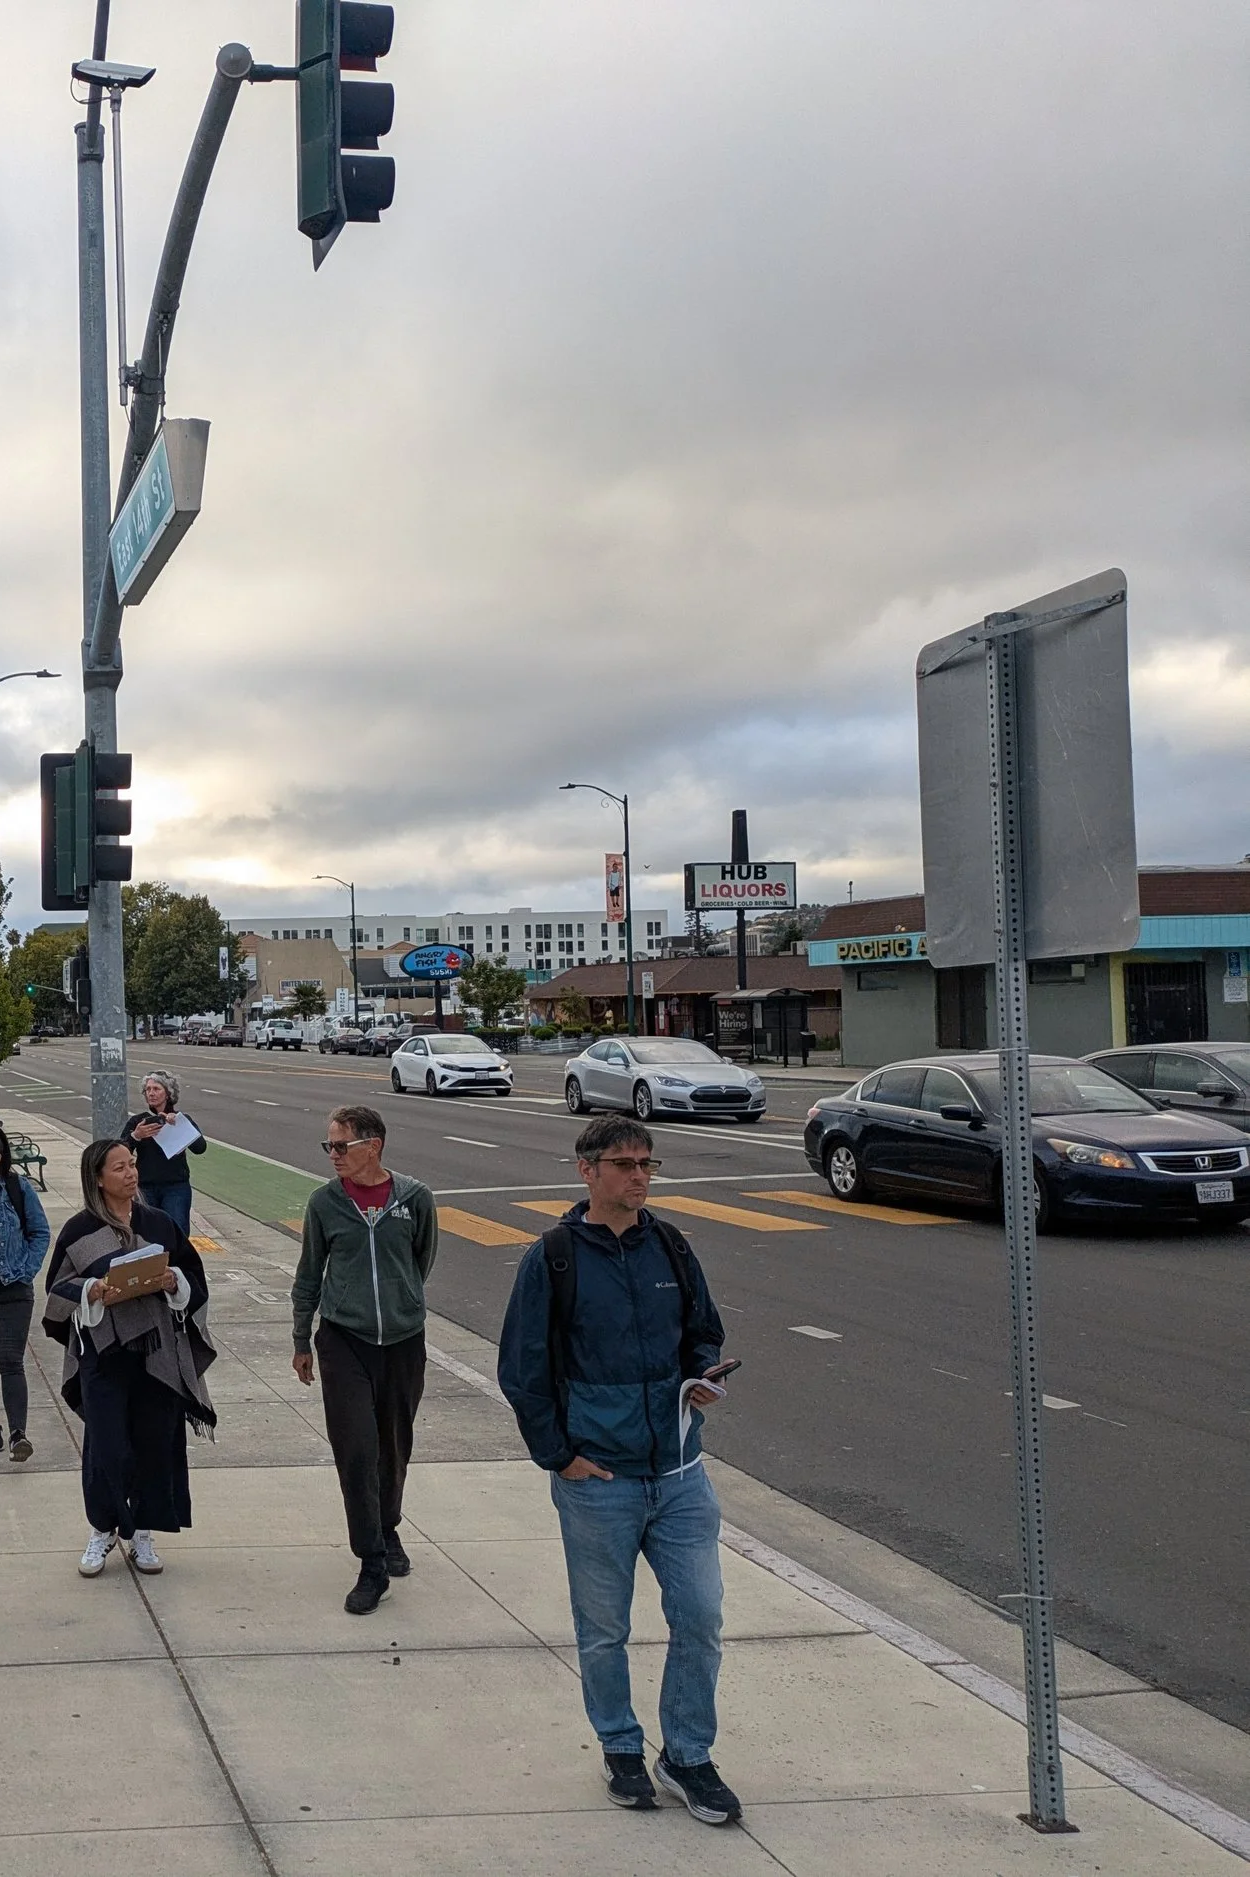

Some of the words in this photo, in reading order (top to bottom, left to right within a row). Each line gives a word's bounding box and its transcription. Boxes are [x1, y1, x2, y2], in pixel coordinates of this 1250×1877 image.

[116, 529, 134, 573] East
[132, 494, 152, 545] 14th
[151, 465, 166, 511] St
[720, 865, 768, 881] HUB
[701, 883, 787, 898] LIQUORS
[837, 938, 913, 960] PACIFIC
[415, 950, 445, 960] ANGRY
[415, 959, 437, 968] FISH
[430, 968, 452, 976] SUSHI
[718, 1010, 746, 1020] We're
[719, 1019, 748, 1030] Hiring
